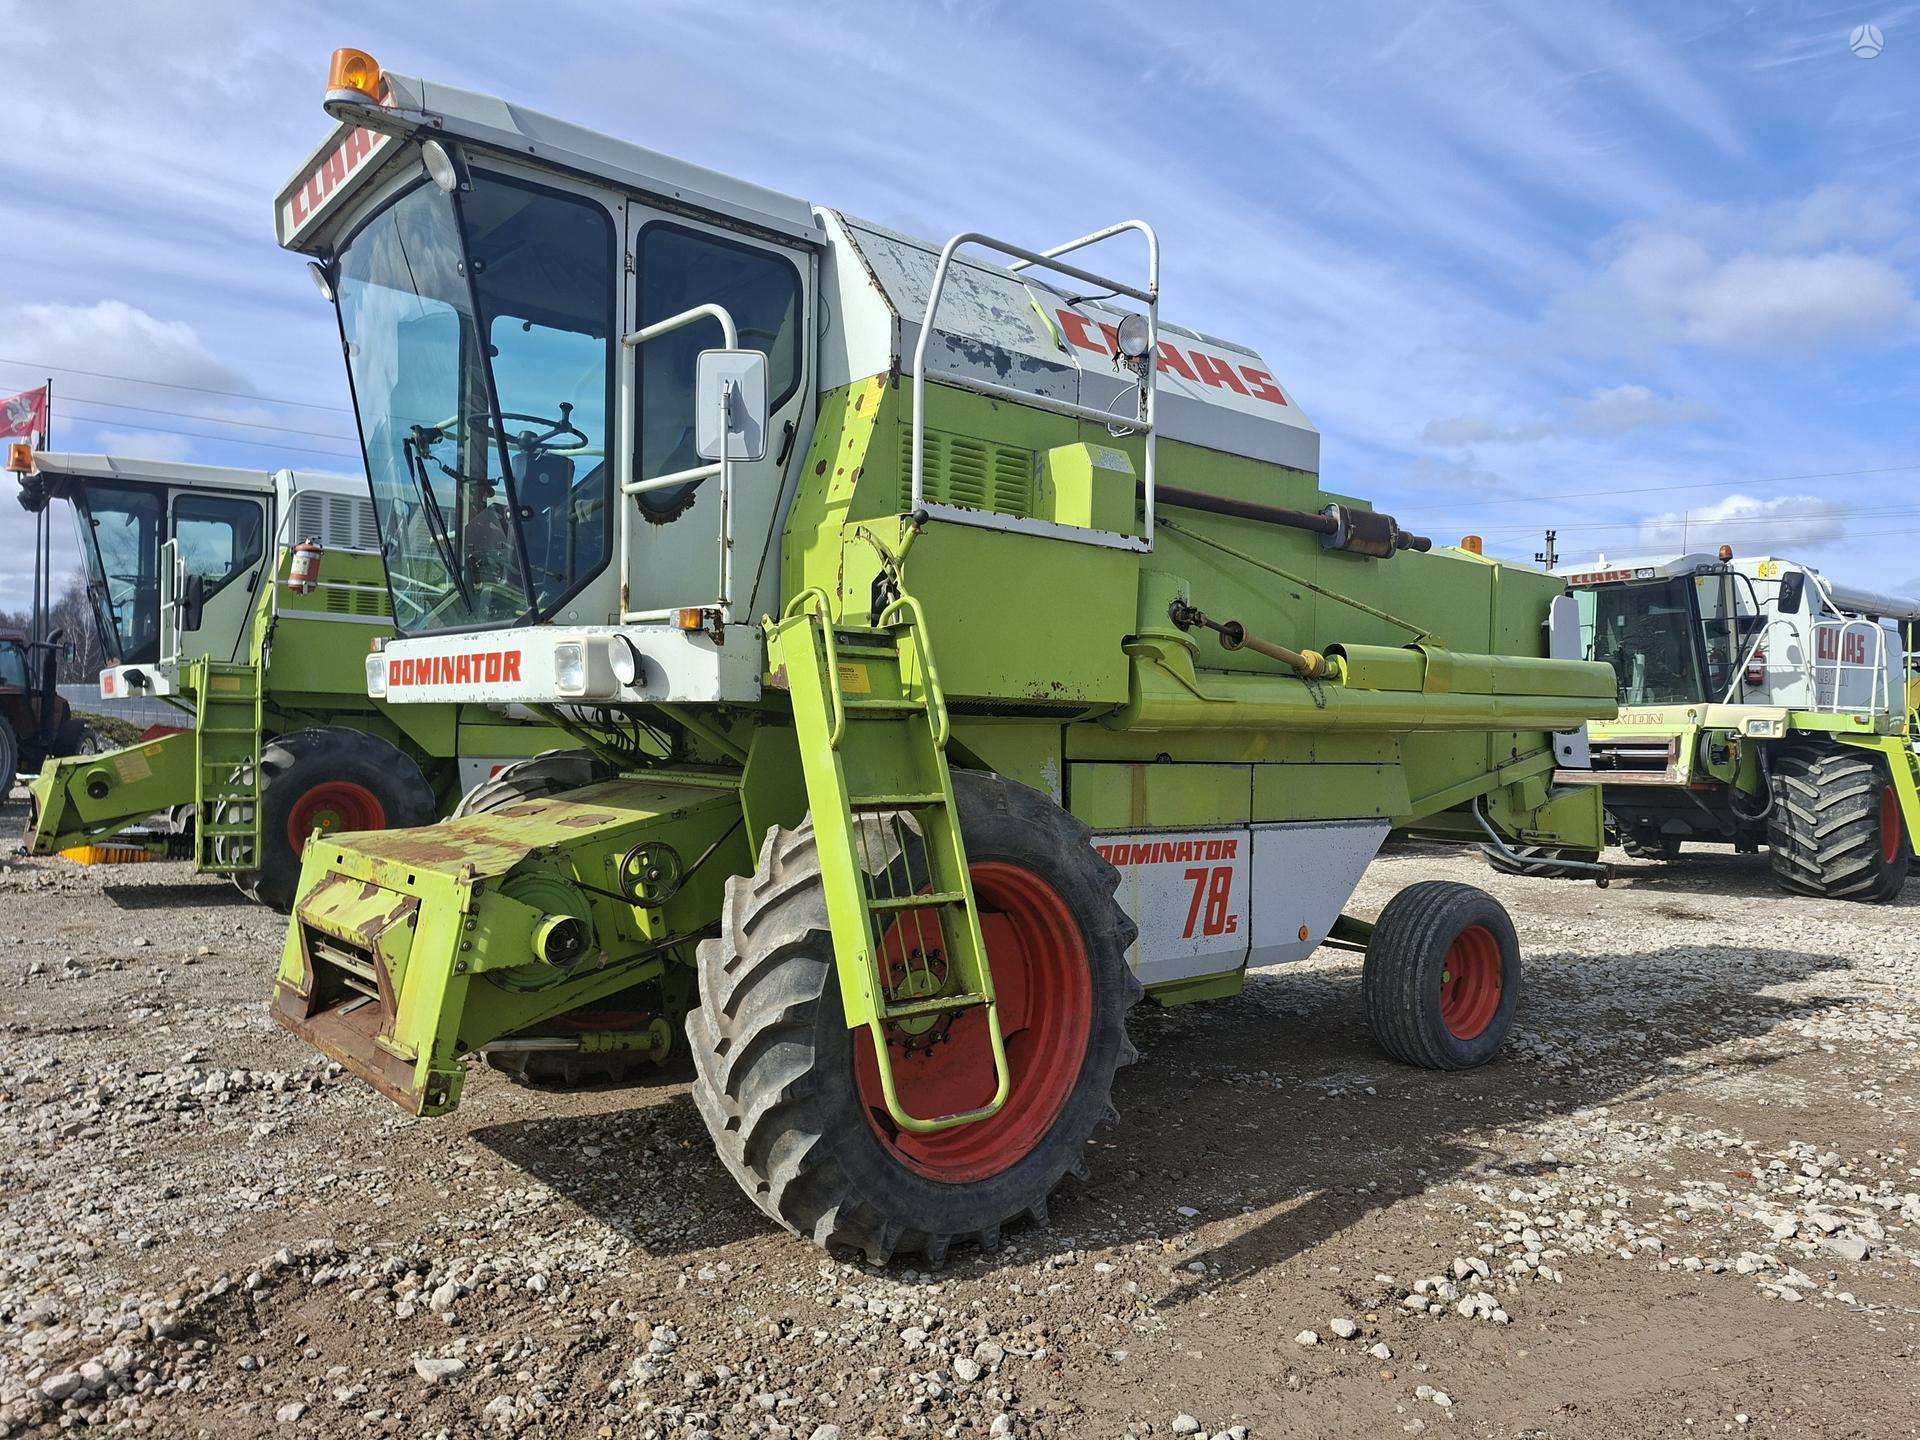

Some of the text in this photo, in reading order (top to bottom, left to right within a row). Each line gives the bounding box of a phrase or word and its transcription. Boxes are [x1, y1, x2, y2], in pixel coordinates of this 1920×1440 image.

[291, 125, 386, 229] CLAA
[1571, 570, 1632, 584] CLAAS
[389, 650, 522, 686] DOMINATOR
[1594, 713, 1664, 726] XION
